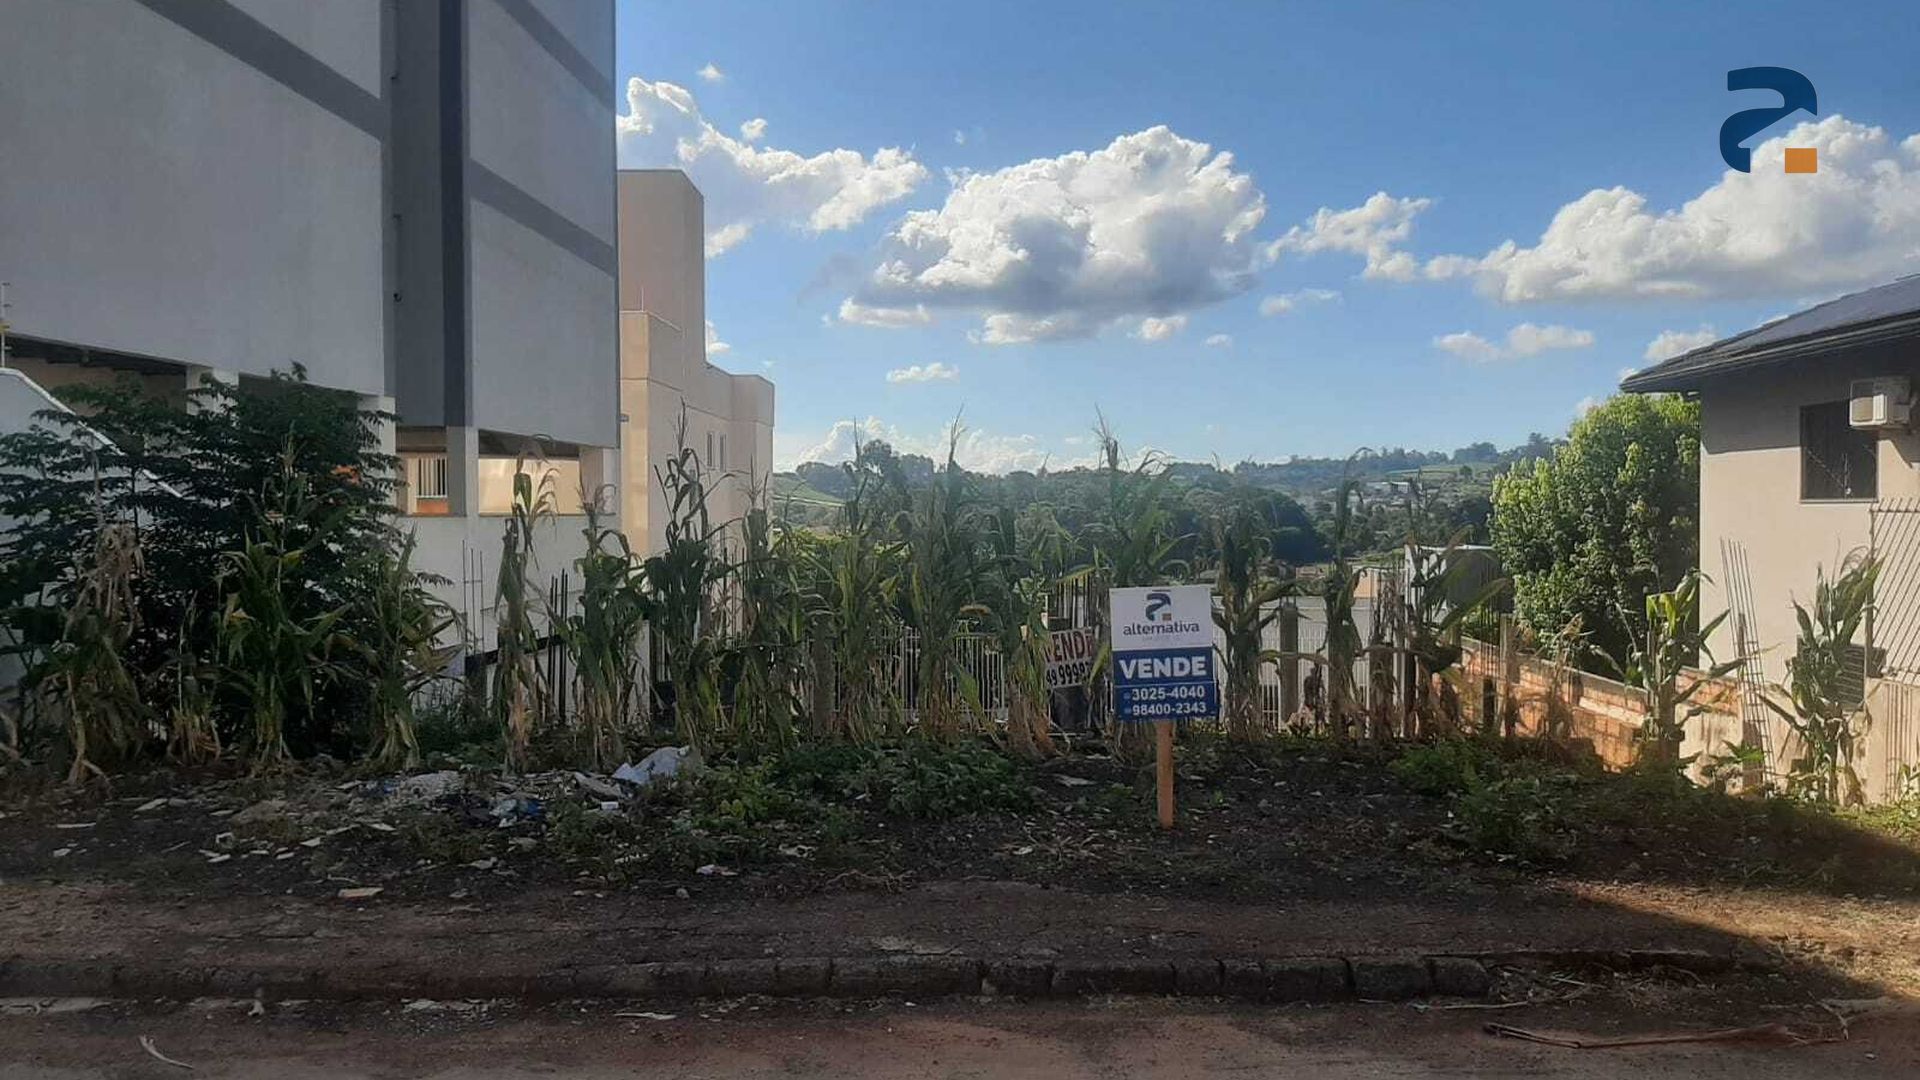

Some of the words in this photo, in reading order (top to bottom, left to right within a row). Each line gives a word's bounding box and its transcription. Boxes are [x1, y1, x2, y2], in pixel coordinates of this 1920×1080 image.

[1122, 620, 1200, 636] alternativa
[1118, 655, 1207, 679] VENDE
[1131, 685, 1205, 701] 3025-4040
[1131, 701, 1207, 716] 98400-2343
